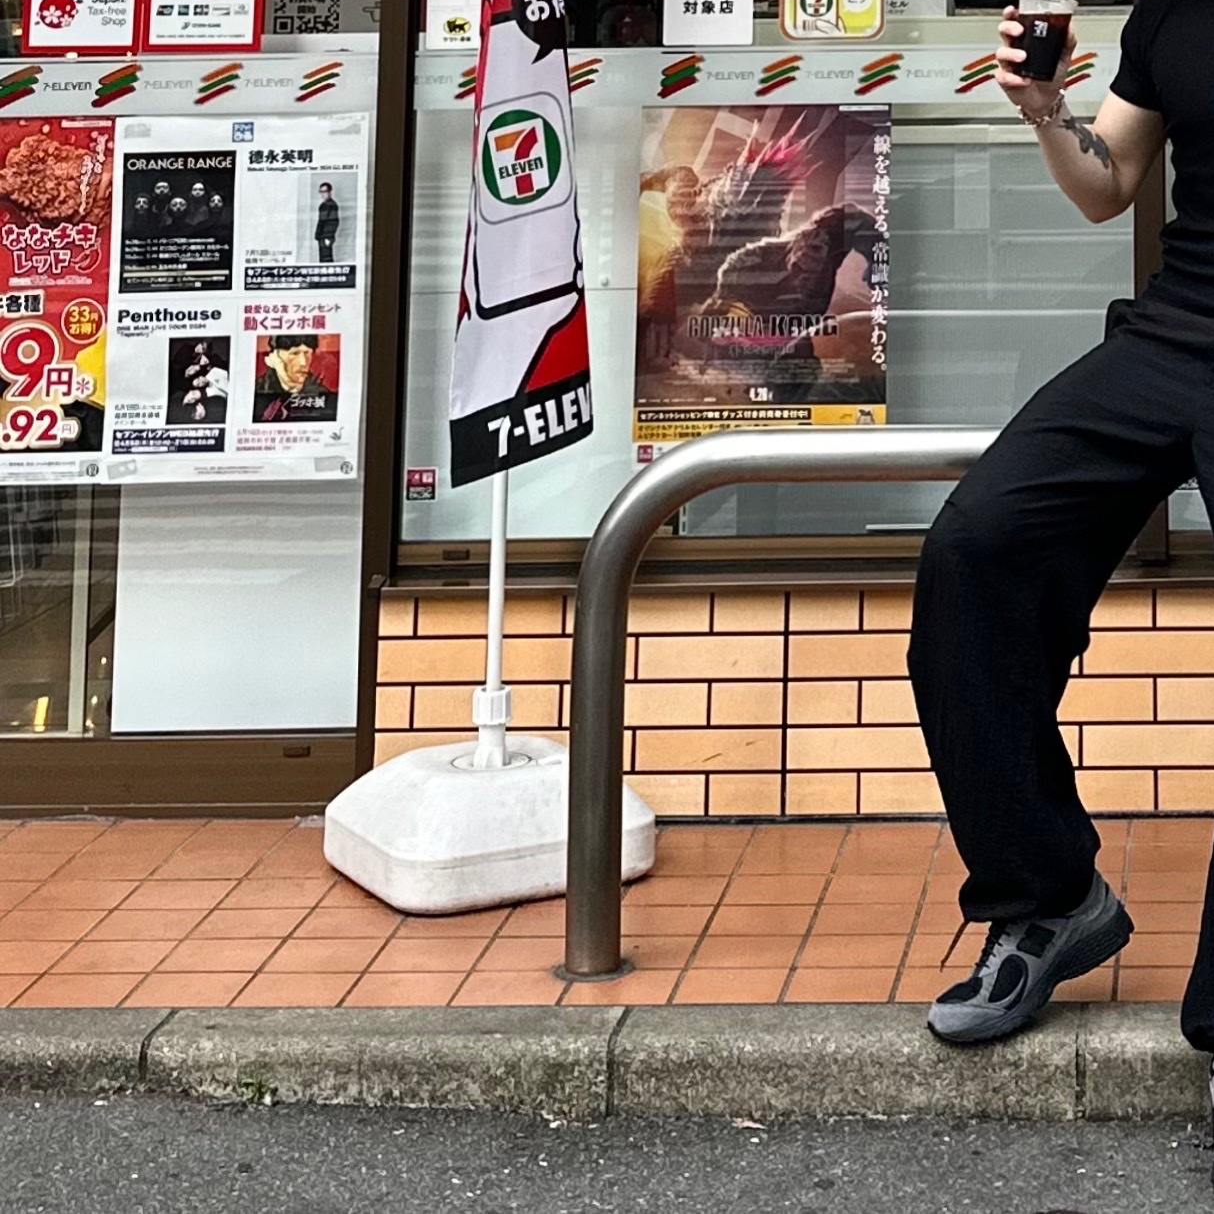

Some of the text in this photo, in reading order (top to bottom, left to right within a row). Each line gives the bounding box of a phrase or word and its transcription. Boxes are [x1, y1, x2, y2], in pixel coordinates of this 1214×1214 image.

[87, 6, 127, 17] Tax-free
[683, 0, 735, 15] 対象店
[101, 17, 127, 27] Shop
[126, 156, 233, 171] ORANGE RANGE
[2, 223, 98, 250] ななチキ
[870, 120, 892, 372] 一線を越える。常識が変わる。
[13, 250, 71, 274] レッド
[118, 308, 222, 324] Penthouse
[244, 303, 342, 314] 親愛なる友 フィンセント
[243, 315, 326, 331] 動くゴッホ展
[687, 314, 840, 338] GODZILLA KONG
